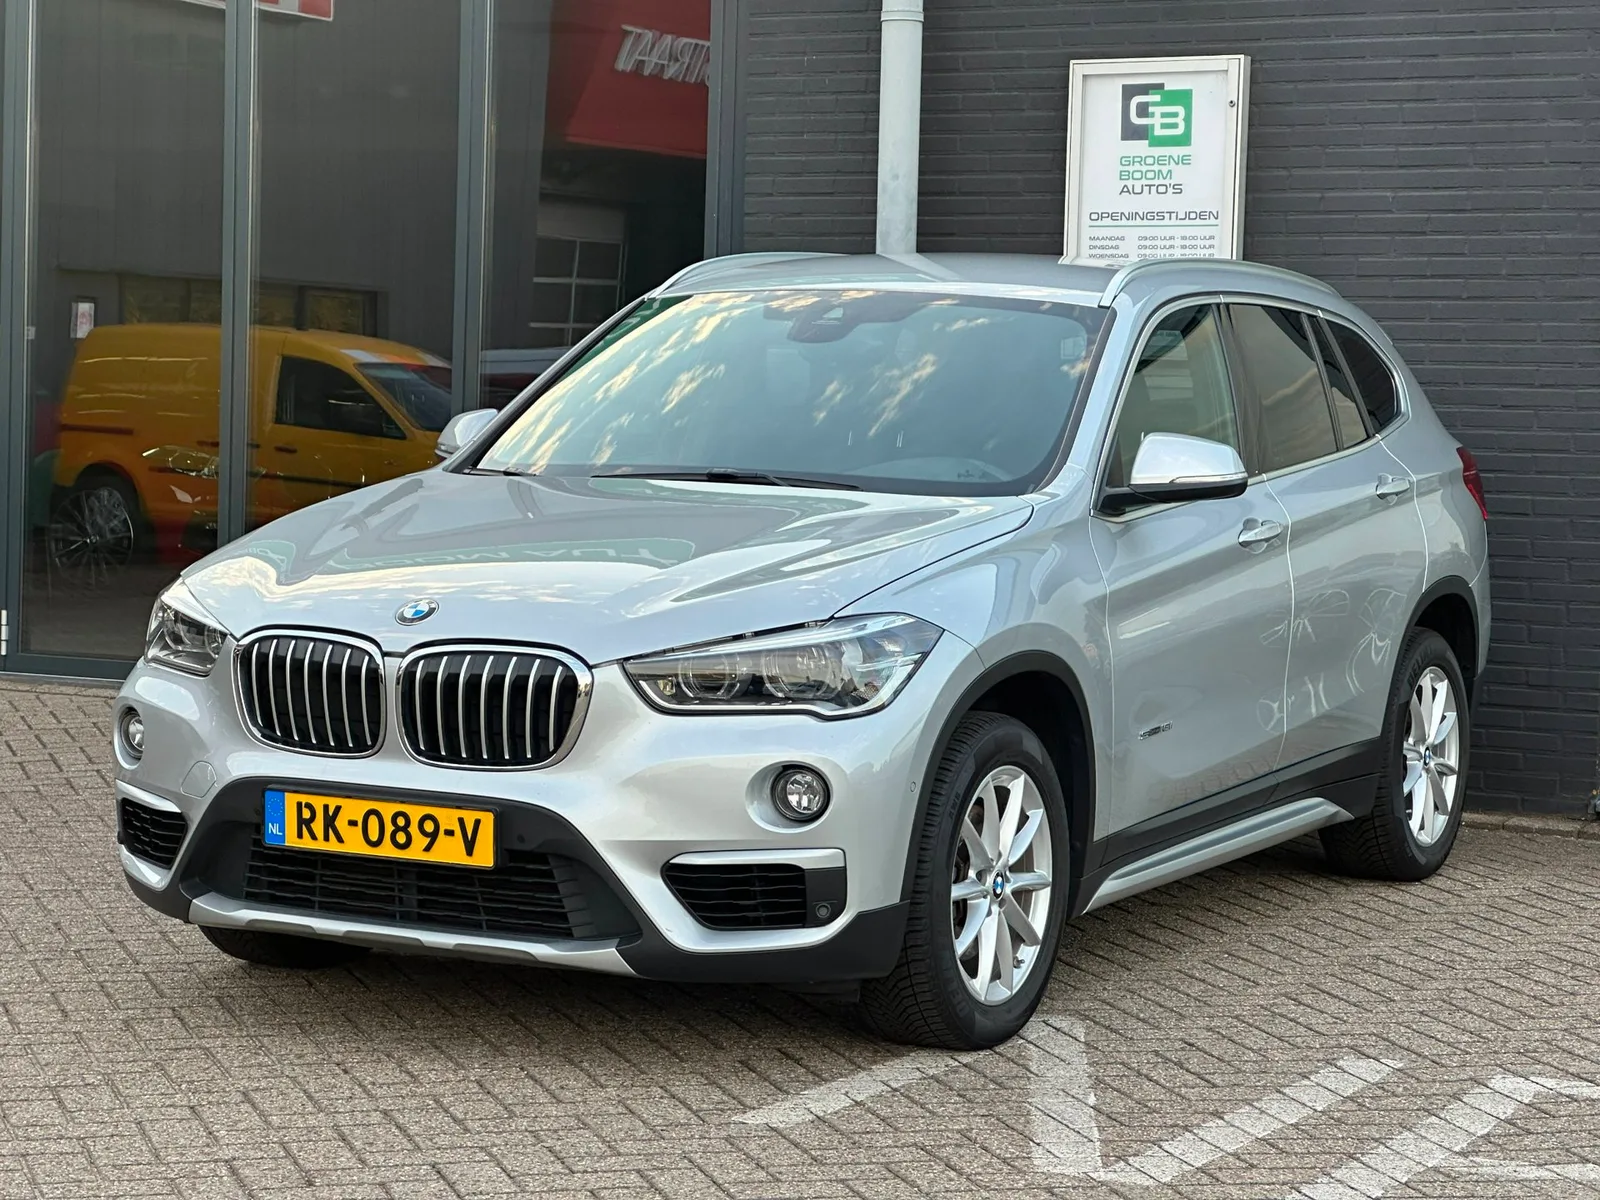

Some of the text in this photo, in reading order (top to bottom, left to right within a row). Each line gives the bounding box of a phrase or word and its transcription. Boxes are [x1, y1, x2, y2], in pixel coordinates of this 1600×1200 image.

[1120, 154, 1191, 166] GROENE
[1119, 170, 1172, 181] BOOM
[1119, 183, 1183, 195] AUTO'S
[1089, 211, 1219, 221] OPENINGSTIJDEN
[268, 823, 283, 836] NL
[296, 801, 482, 857] RK-089-V
